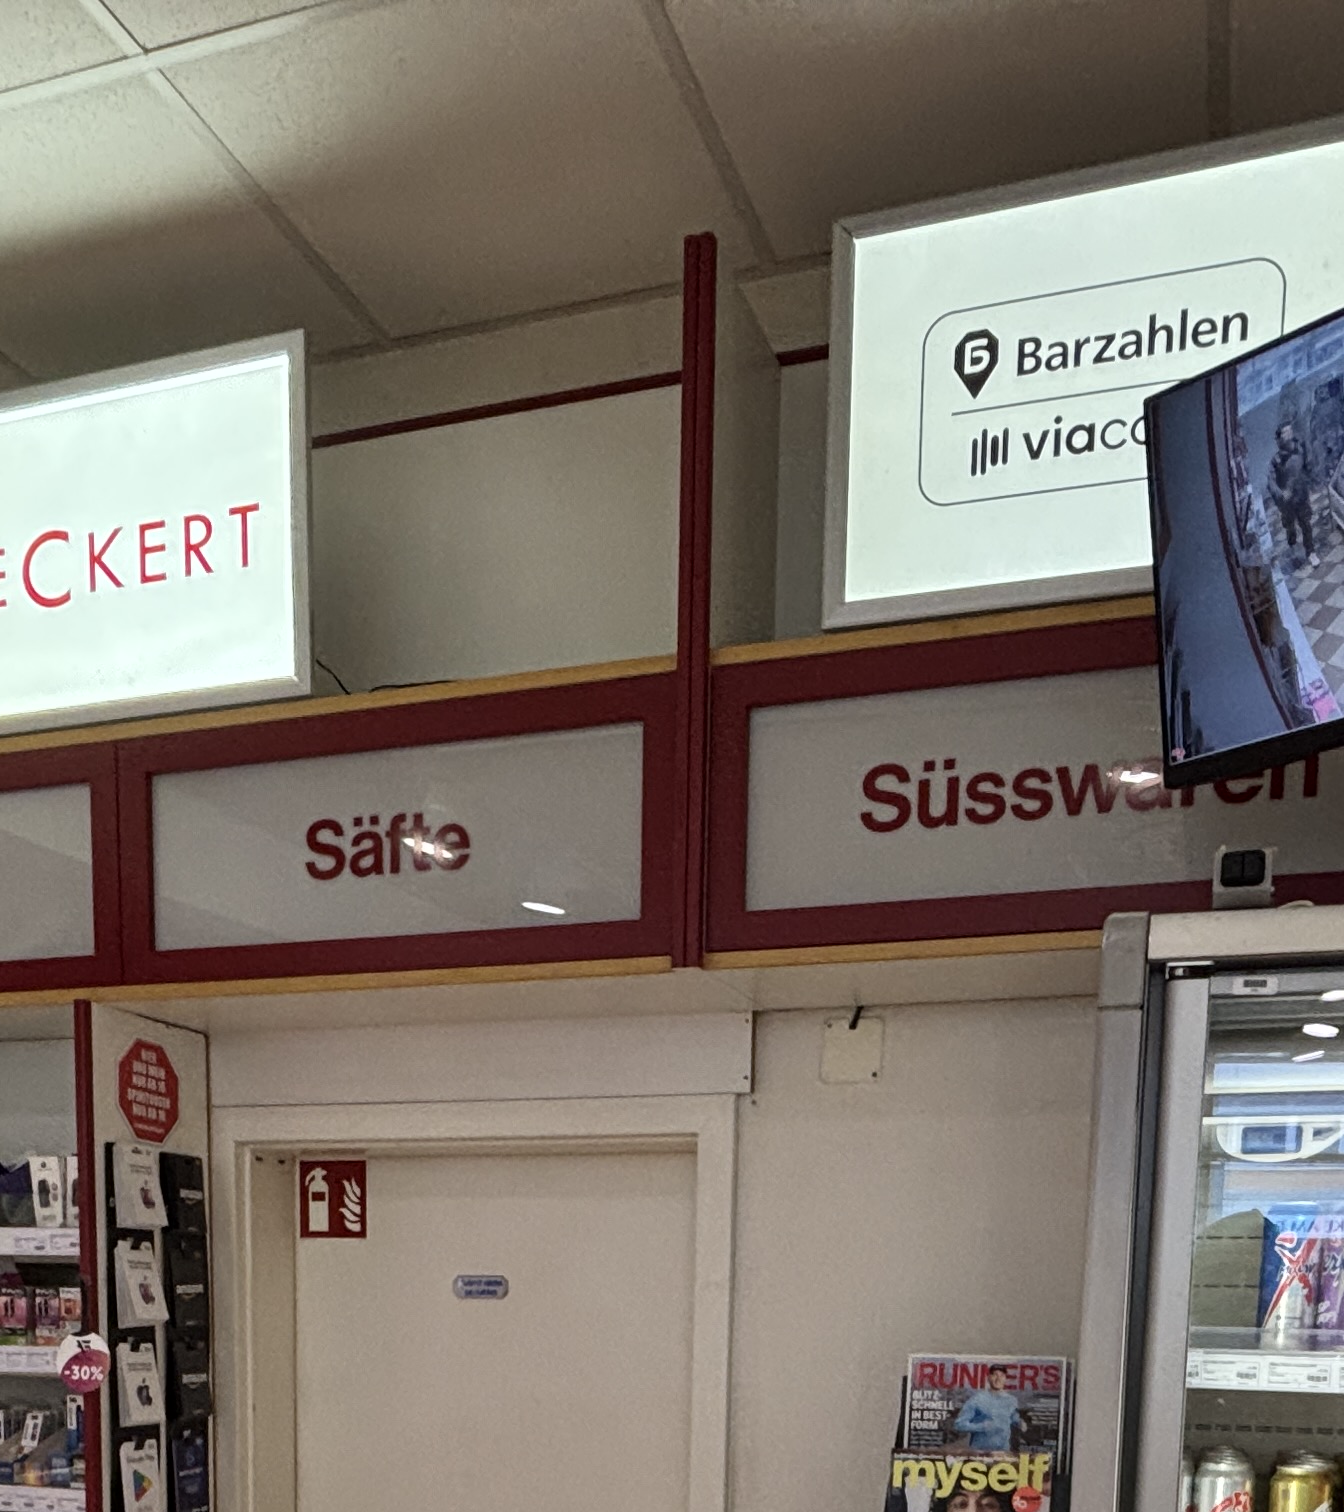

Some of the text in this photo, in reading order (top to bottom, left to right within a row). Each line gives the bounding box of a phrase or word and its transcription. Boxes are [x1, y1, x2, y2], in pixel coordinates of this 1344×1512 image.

[1015, 306, 1250, 378] Barzahlen
[304, 813, 470, 880] Säfte
[62, 1364, 104, 1383] -30%
[911, 1400, 955, 1411] SCHNELL
[911, 1420, 939, 1430] FORM
[892, 1453, 1050, 1499] myself
